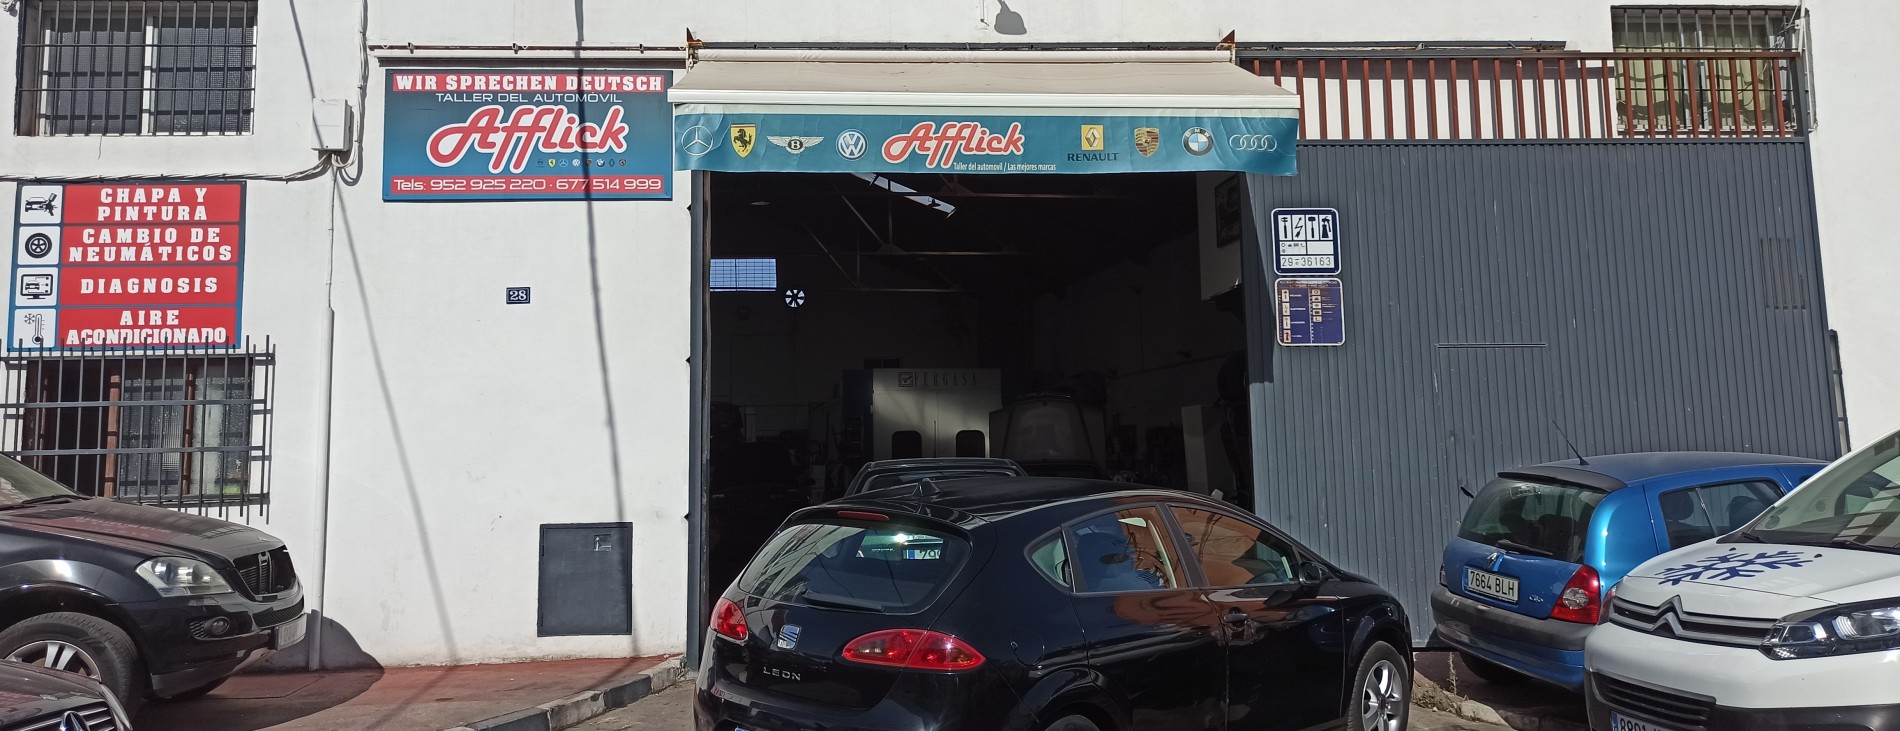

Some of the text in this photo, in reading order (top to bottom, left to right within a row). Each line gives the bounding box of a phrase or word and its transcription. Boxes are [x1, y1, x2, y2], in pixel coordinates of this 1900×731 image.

[396, 75, 662, 91] WIR SPRECHEN DEUTSCH
[436, 91, 622, 103] TALLER DEL AUTOMÓVIL
[426, 105, 629, 173] Afflick
[882, 121, 1025, 168] Afflick
[1067, 152, 1119, 162] RENAULT
[953, 162, 967, 171] Taller
[968, 162, 977, 171] del
[1007, 163, 1016, 171] Las
[394, 179, 427, 191] Tels:
[430, 179, 468, 191] 952
[470, 179, 506, 191] 925
[510, 179, 546, 191] 220
[556, 179, 590, 191] 677
[593, 179, 620, 190] 514
[624, 179, 662, 190] 999
[101, 187, 208, 204] CHAPA Y
[97, 205, 207, 221] PINTURA
[82, 227, 221, 244] CAMBIO DE
[69, 242, 232, 262] NEUMÁTICOS
[80, 277, 218, 294] DIAGNOSIS
[509, 290, 527, 301] 28
[120, 309, 180, 326] AIRE
[66, 327, 227, 345] ACONDICIONADO
[1470, 571, 1515, 597] 7664 BLH
